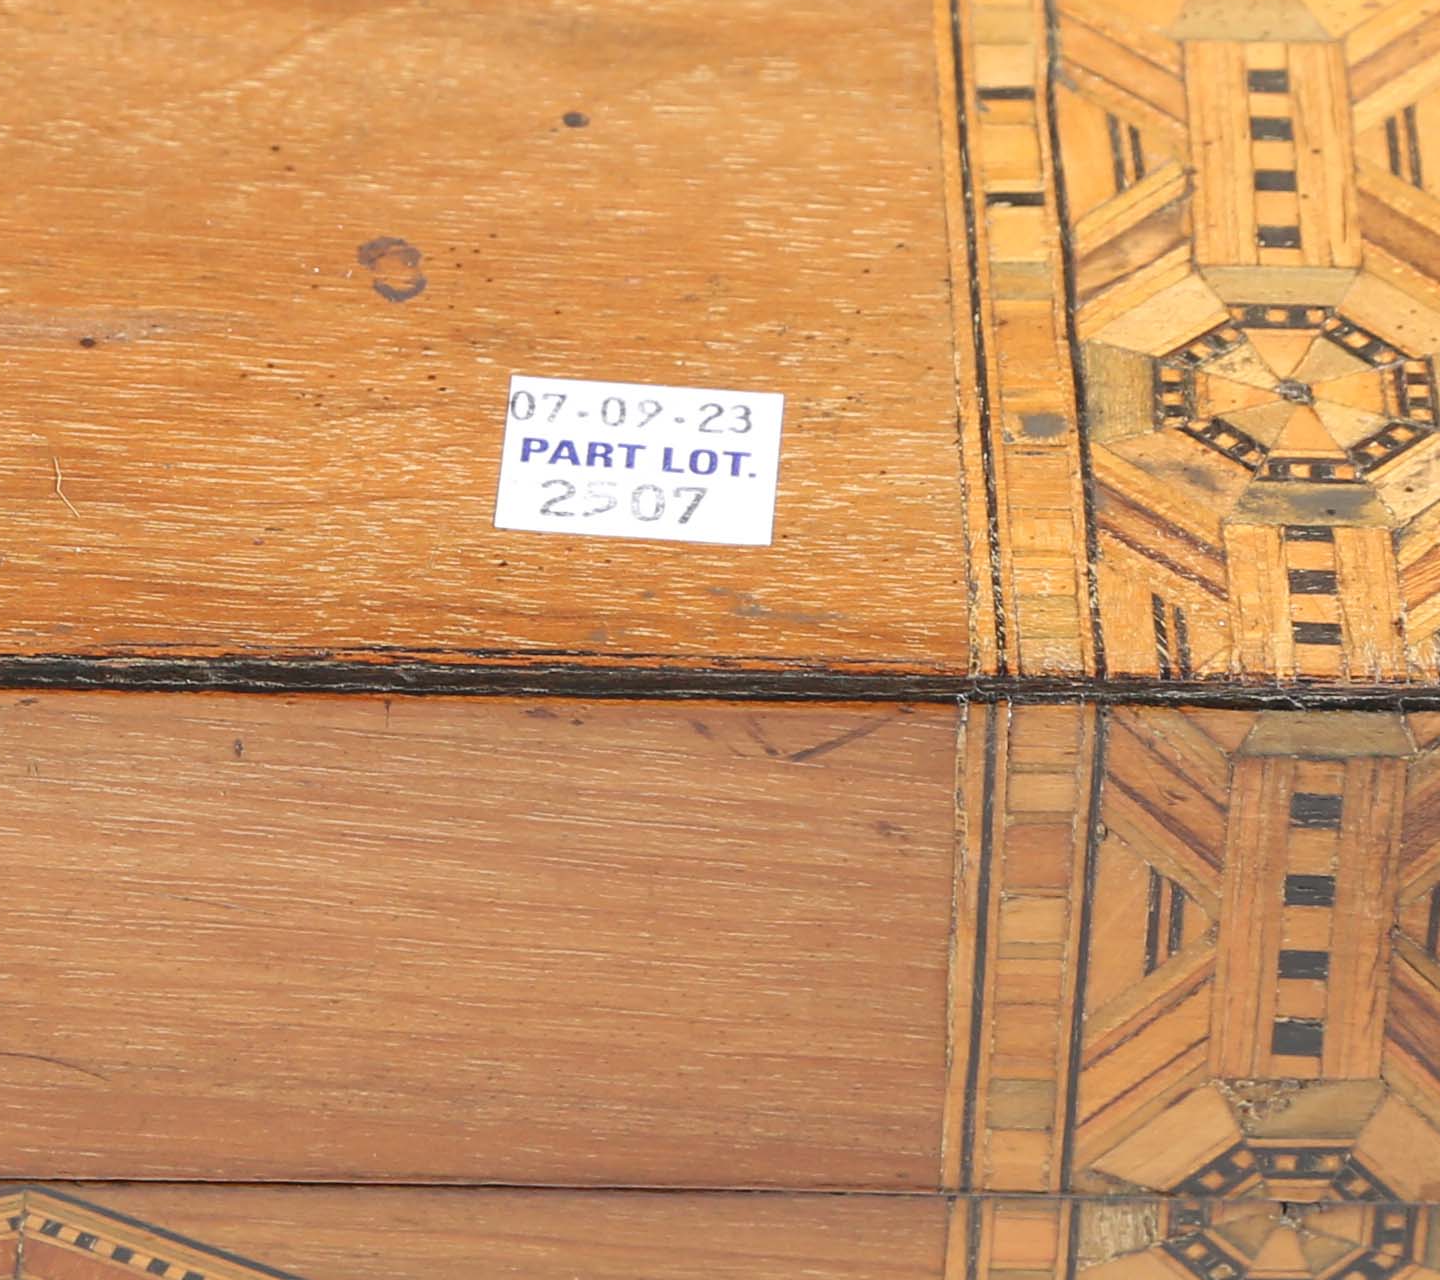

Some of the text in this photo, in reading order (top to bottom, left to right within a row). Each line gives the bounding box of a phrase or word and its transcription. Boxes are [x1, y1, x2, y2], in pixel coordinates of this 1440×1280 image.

[520, 437, 757, 478] PART LOT.
[539, 479, 708, 524] 2507
